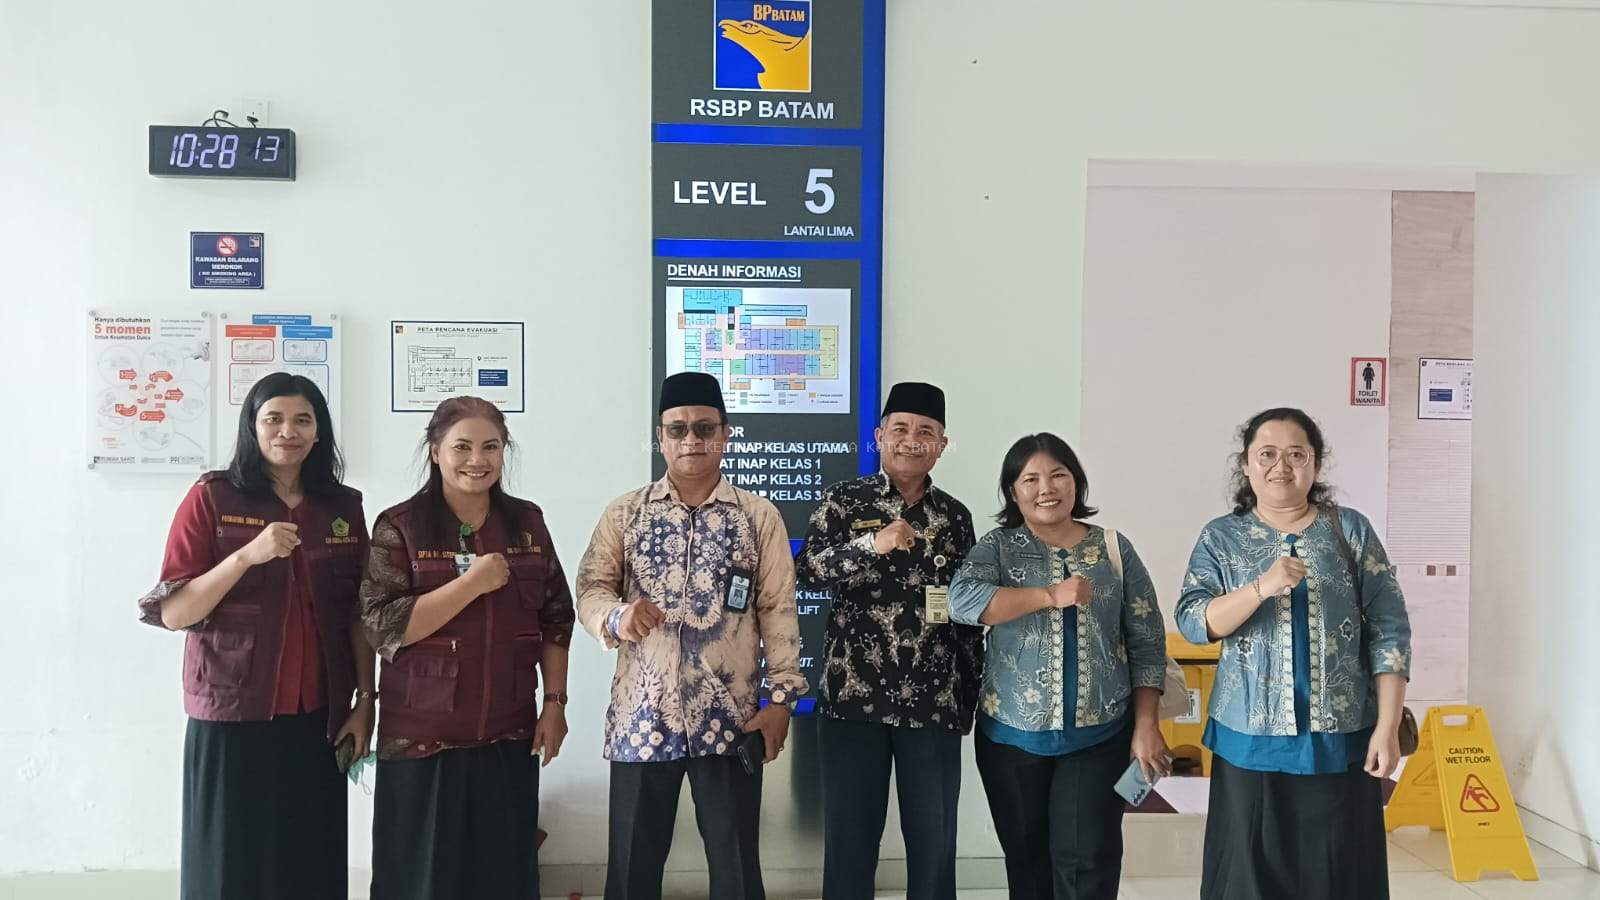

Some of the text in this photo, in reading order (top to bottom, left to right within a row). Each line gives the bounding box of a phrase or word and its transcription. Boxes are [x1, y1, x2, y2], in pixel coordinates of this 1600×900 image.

[753, 4, 805, 22] BP BATAM
[690, 99, 834, 119] RSBP BATAM
[169, 133, 280, 169] 10:28 13
[673, 168, 836, 215] LEVEL 5
[784, 225, 854, 237] LANTAI LIMA
[667, 264, 801, 279] DENAH INFORMASI
[94, 323, 151, 335] 5 momen
[734, 442, 763, 454] INAP
[764, 442, 803, 454] KELAS
[806, 442, 849, 454] UTAMA
[737, 458, 767, 469] INAP
[770, 458, 812, 470] KELAS
[815, 458, 821, 470] 1
[737, 474, 767, 485] INAP
[770, 474, 812, 485] KELAS
[814, 474, 822, 486] 2
[769, 490, 812, 501] KELAS
[814, 490, 822, 501] 3
[797, 605, 820, 615] LIFT
[1448, 747, 1484, 755] CAUTION
[1445, 756, 1491, 765] WET FLOOR
